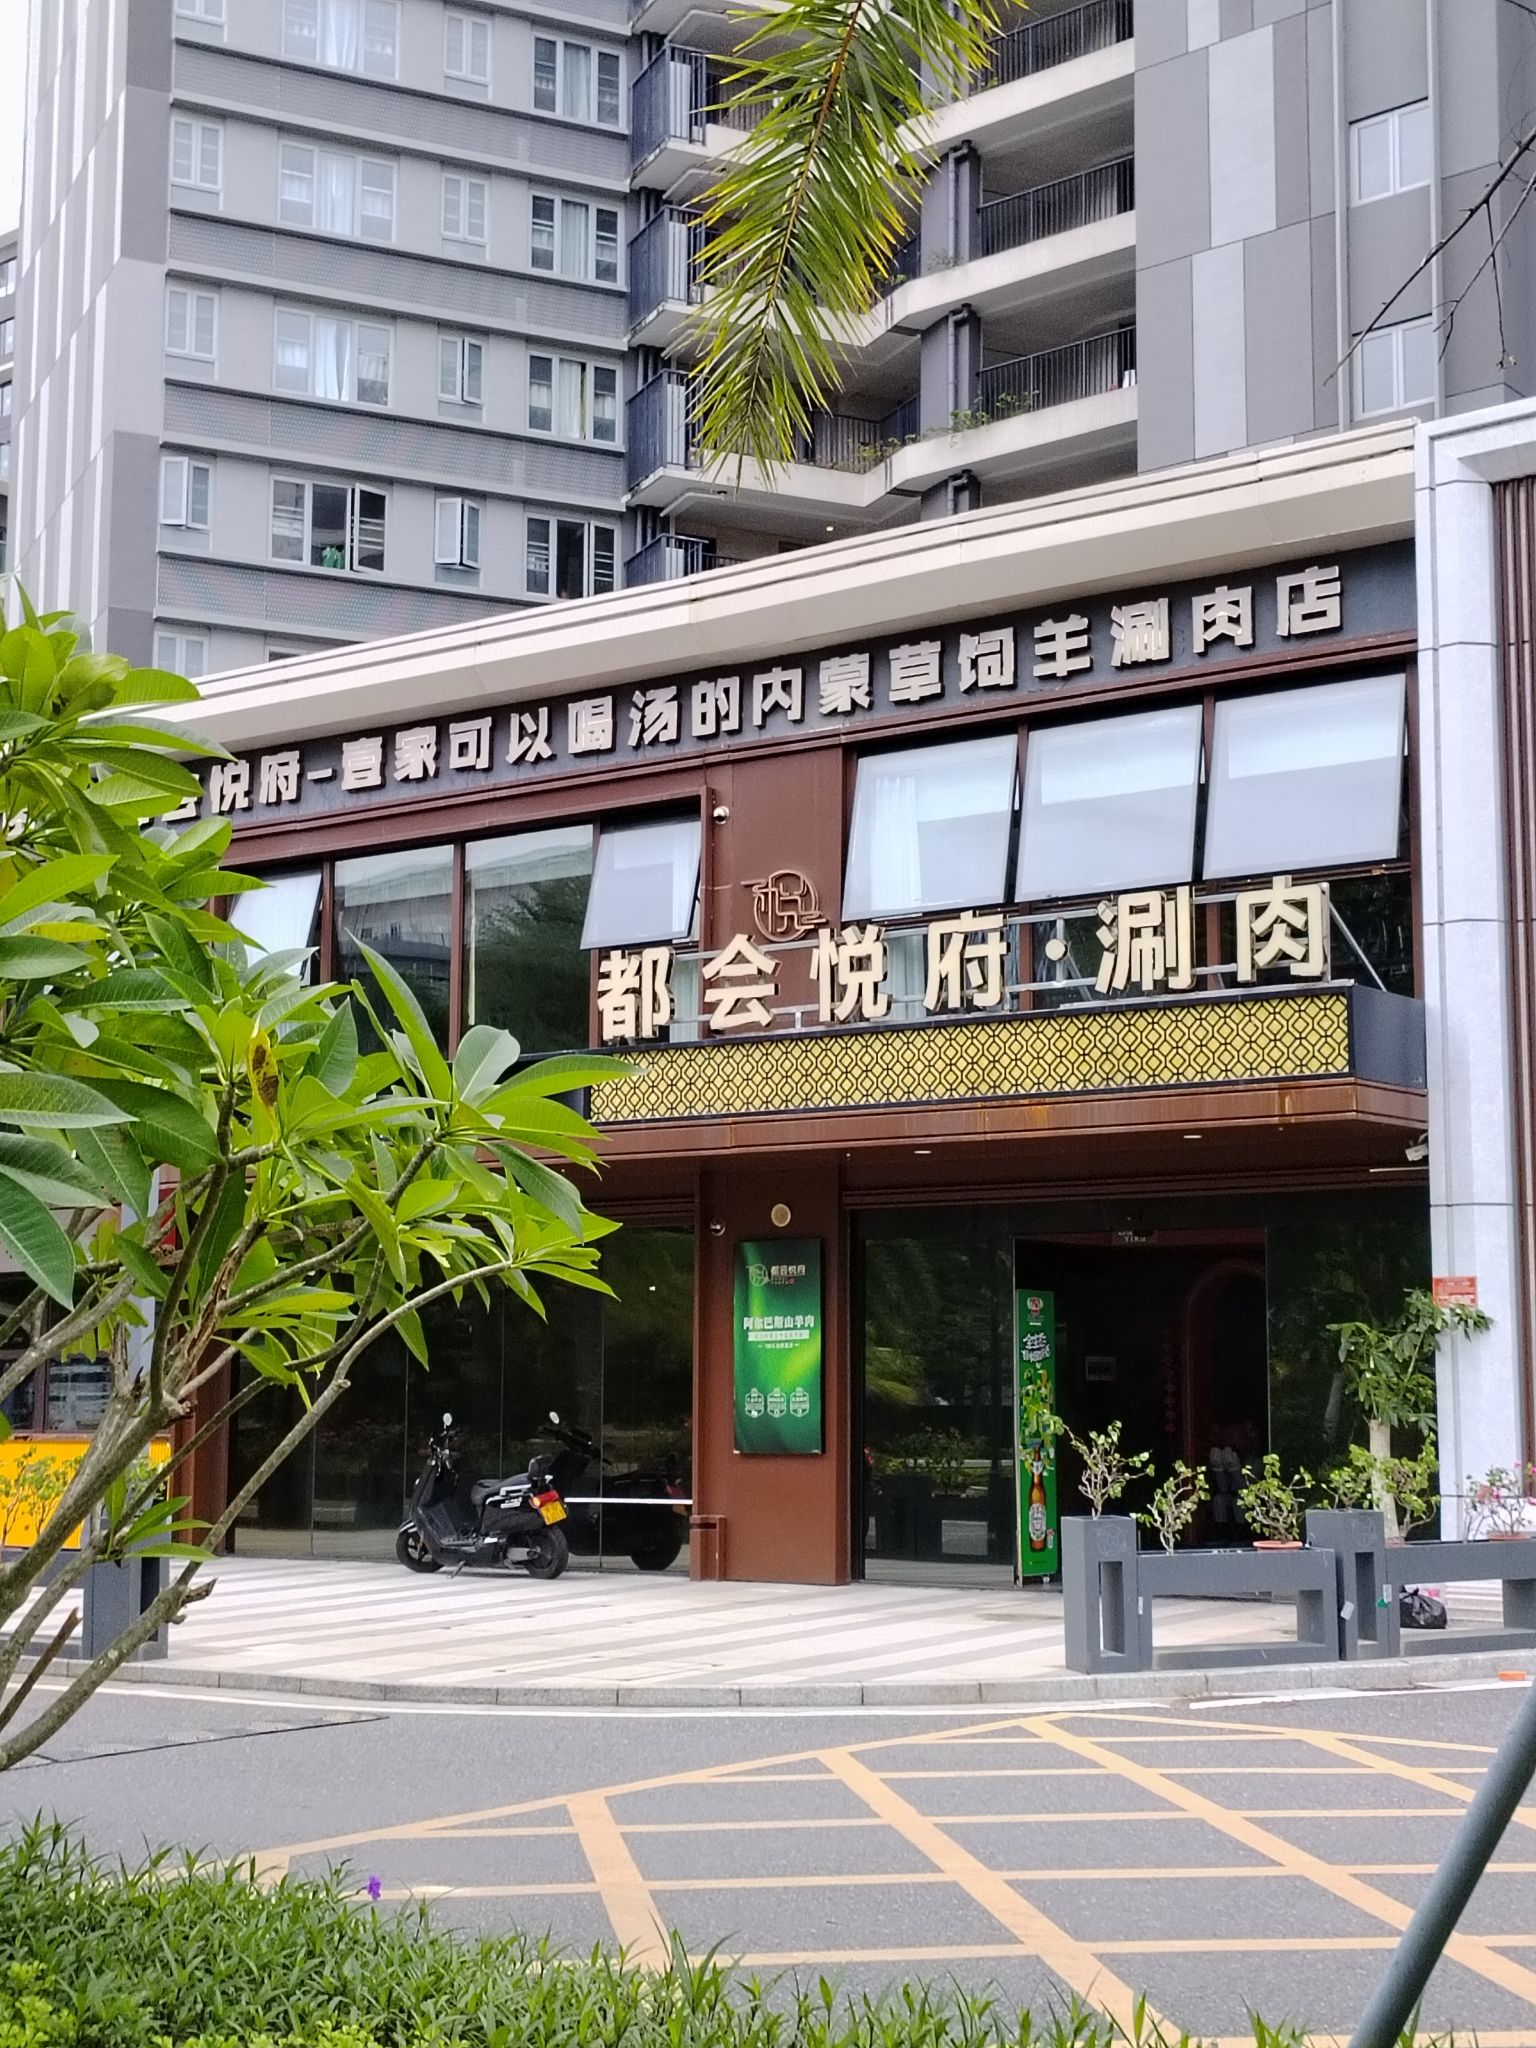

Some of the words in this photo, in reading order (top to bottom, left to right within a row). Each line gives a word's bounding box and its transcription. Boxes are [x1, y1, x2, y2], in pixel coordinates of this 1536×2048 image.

[596, 874, 1330, 1042] 都会悦府·涮肉
